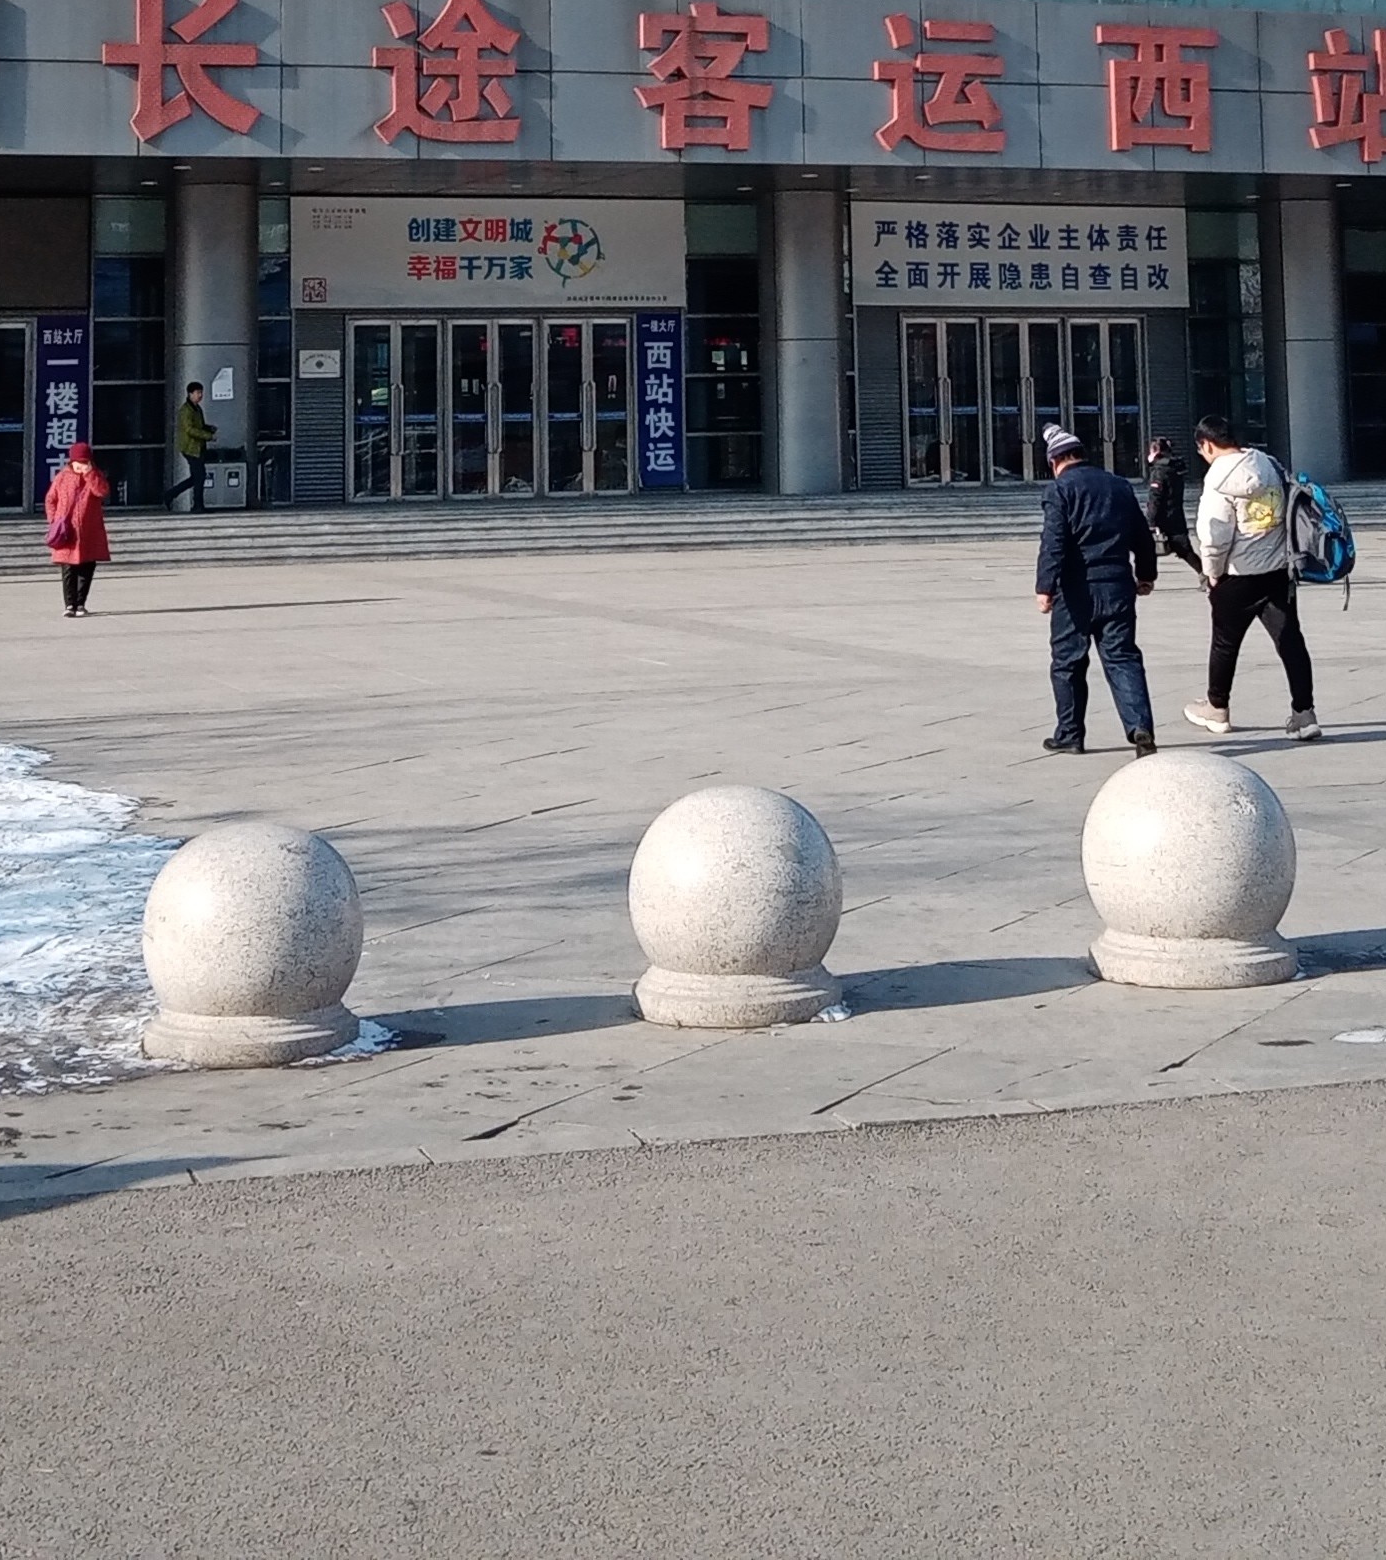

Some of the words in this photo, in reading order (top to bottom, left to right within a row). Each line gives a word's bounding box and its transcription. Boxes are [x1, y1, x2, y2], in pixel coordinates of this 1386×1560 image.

[407, 217, 534, 243] 创建文明城
[874, 220, 1168, 251] 严格落实企业主体责任
[407, 255, 534, 281] 幸福千万家
[874, 260, 1170, 291] 全面开展隐患自查自改
[43, 329, 83, 345] 西站大厅
[644, 341, 676, 472] 西站快运
